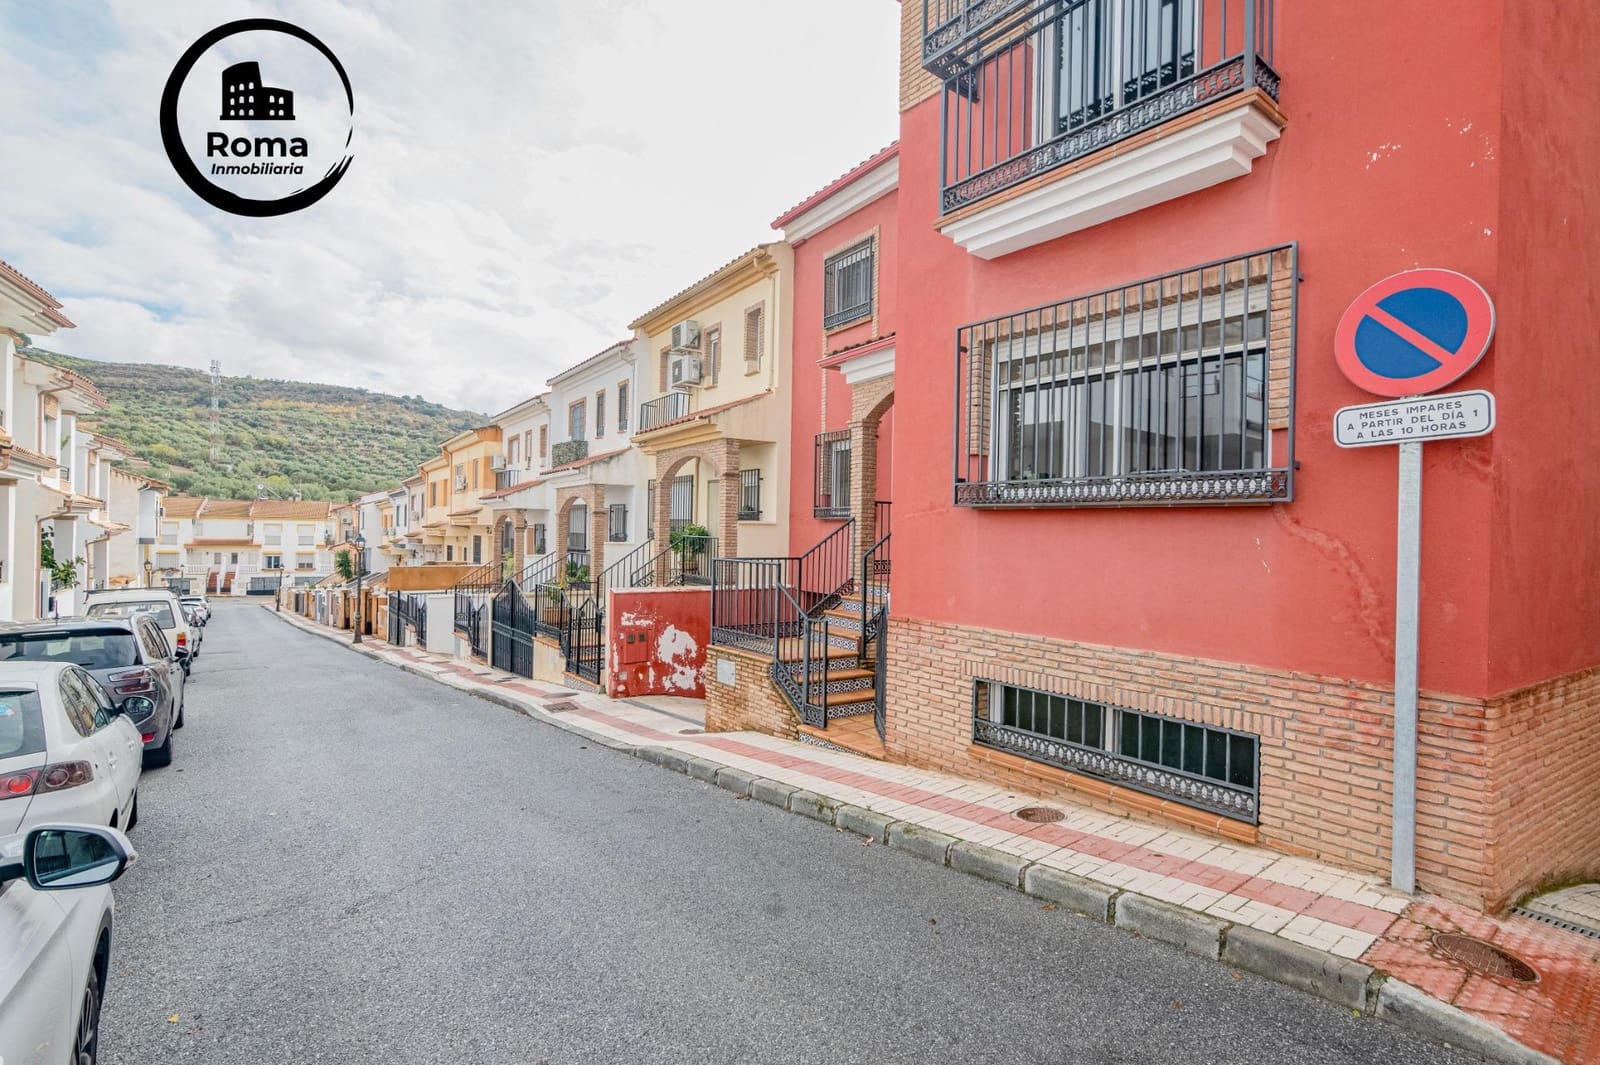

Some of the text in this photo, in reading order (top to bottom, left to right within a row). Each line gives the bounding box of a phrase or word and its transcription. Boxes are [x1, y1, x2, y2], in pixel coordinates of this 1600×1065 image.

[1359, 401, 1462, 419] MESES IMPARES
[1347, 409, 1478, 431] A PARTIR DEL DÍA 1
[1371, 429, 1393, 438] LAS
[1402, 427, 1414, 435] 10
[1421, 421, 1467, 432] HORAS
